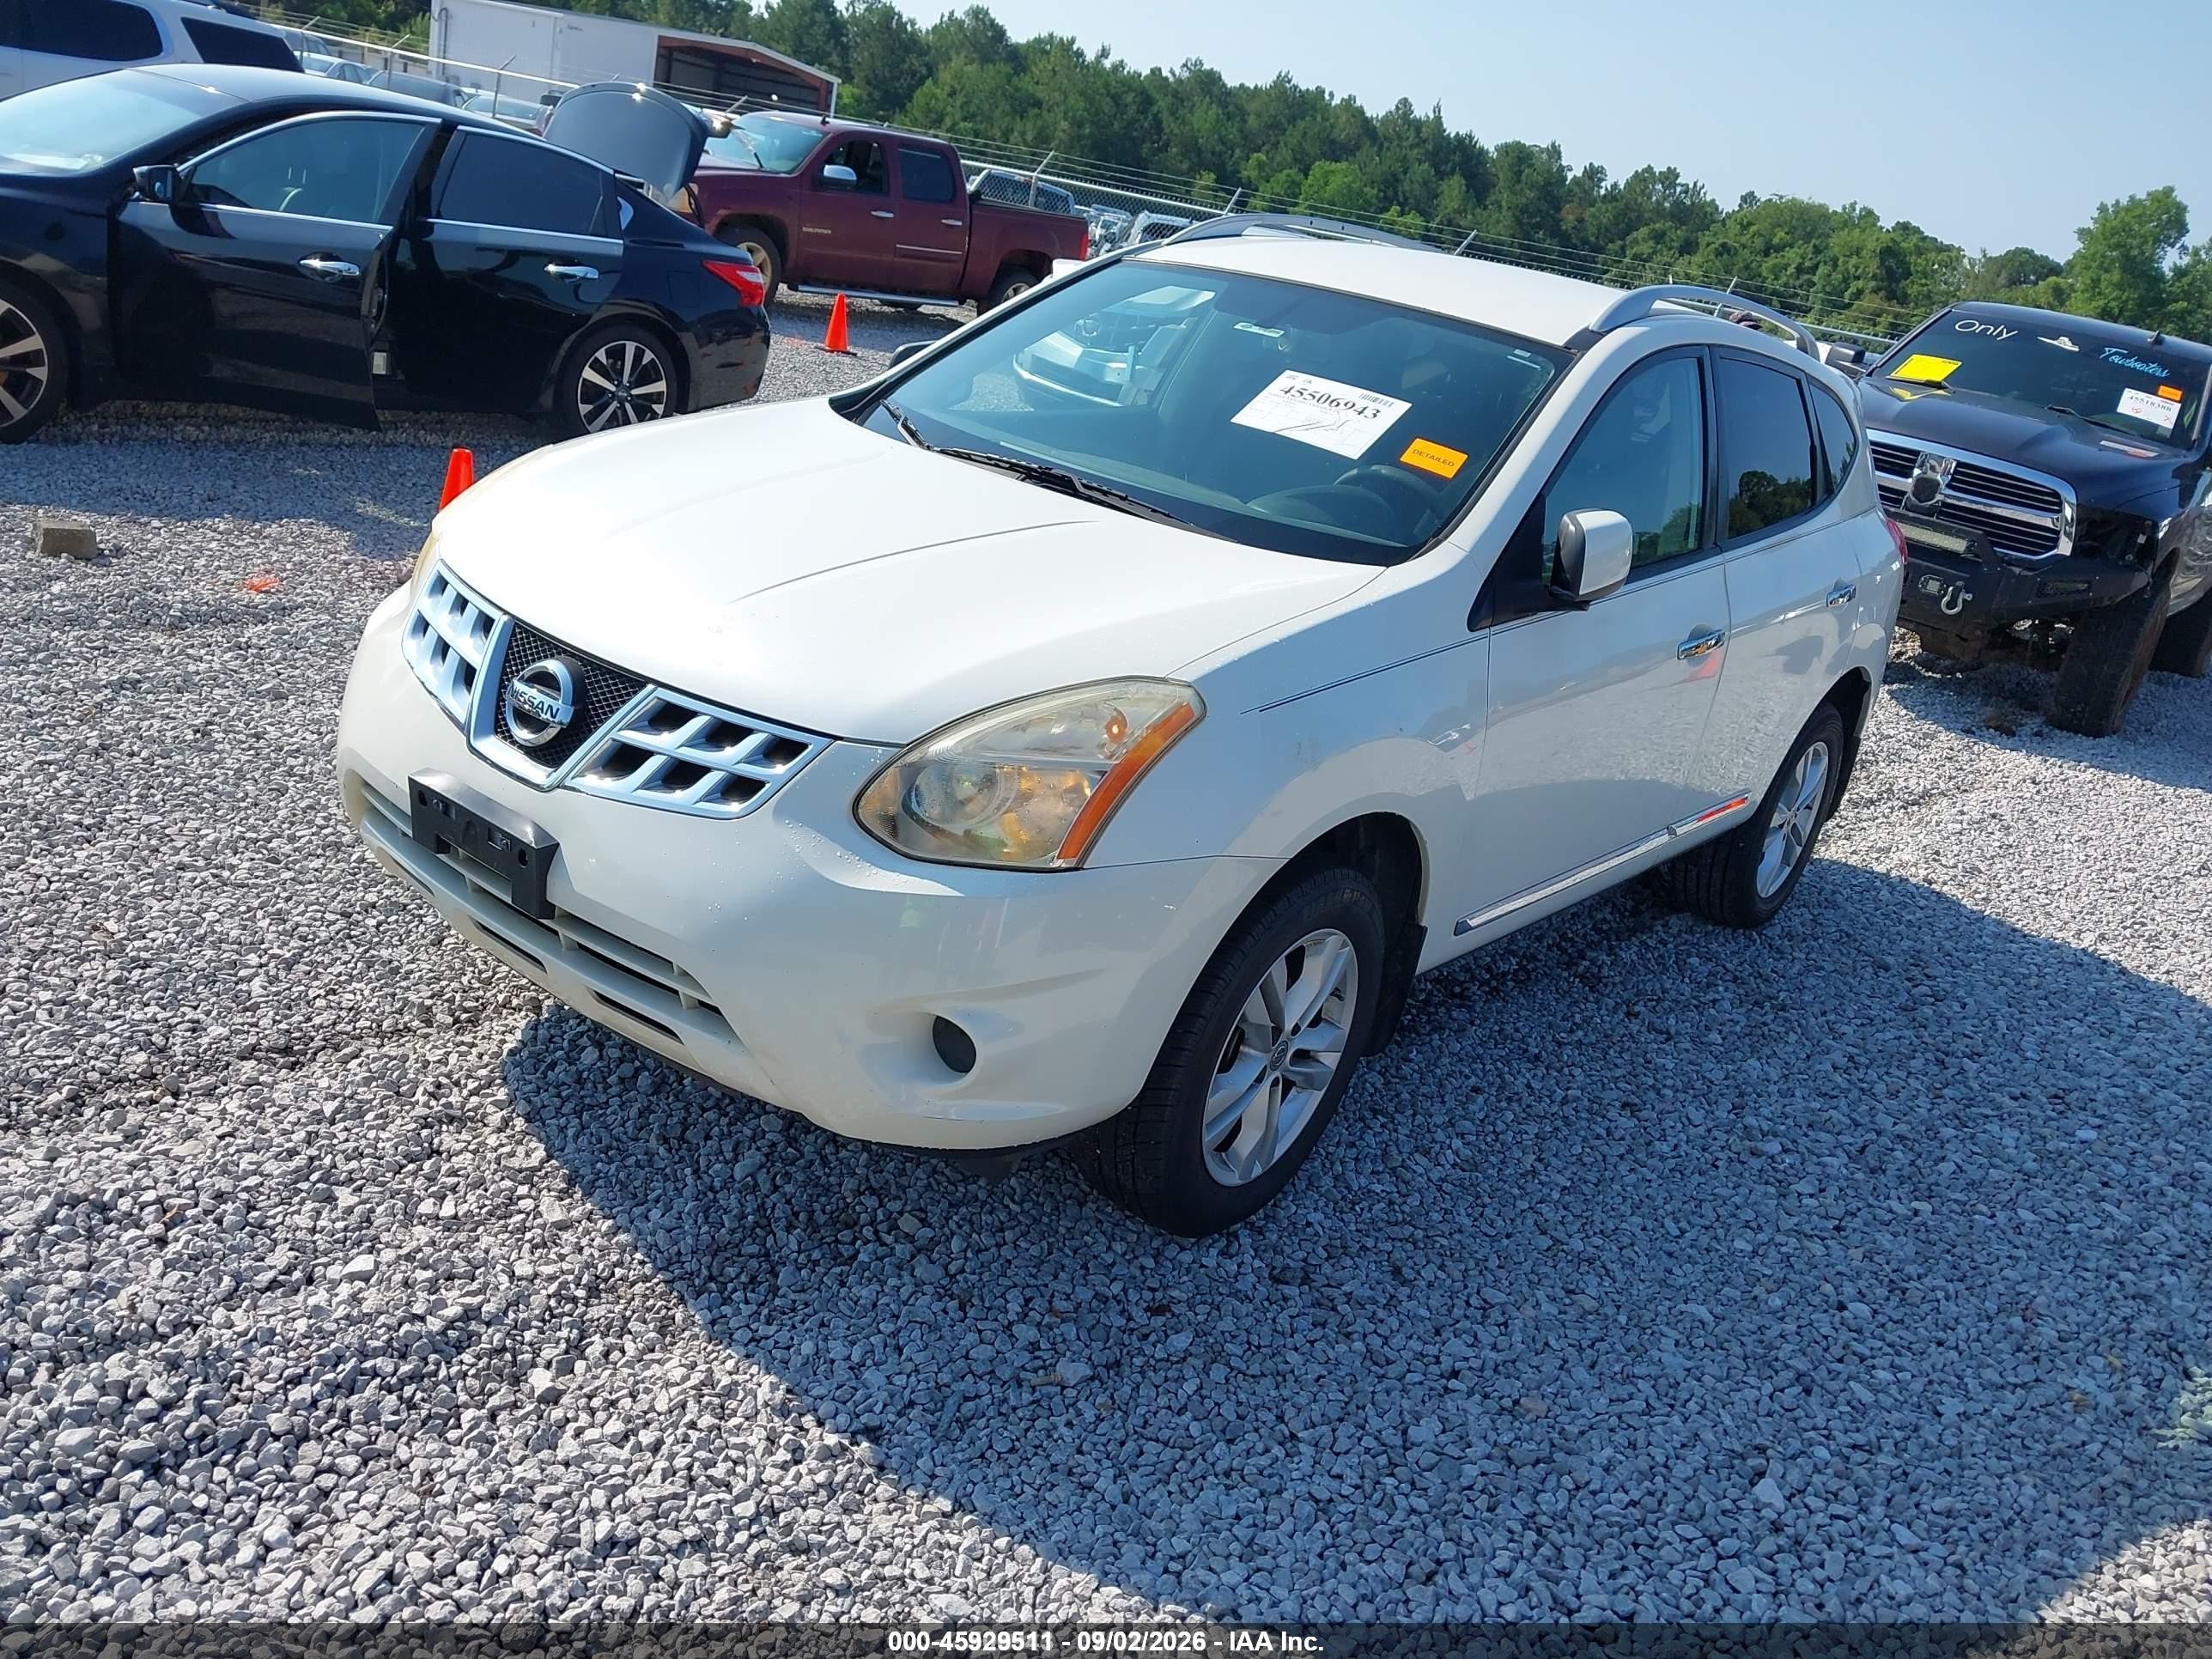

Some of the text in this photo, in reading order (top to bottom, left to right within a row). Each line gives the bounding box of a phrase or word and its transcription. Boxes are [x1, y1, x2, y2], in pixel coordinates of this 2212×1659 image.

[1954, 319, 2019, 341] Only
[1279, 386, 1381, 419] 45506943
[1413, 448, 1455, 467] DETAILED
[507, 686, 560, 720] NISSAN
